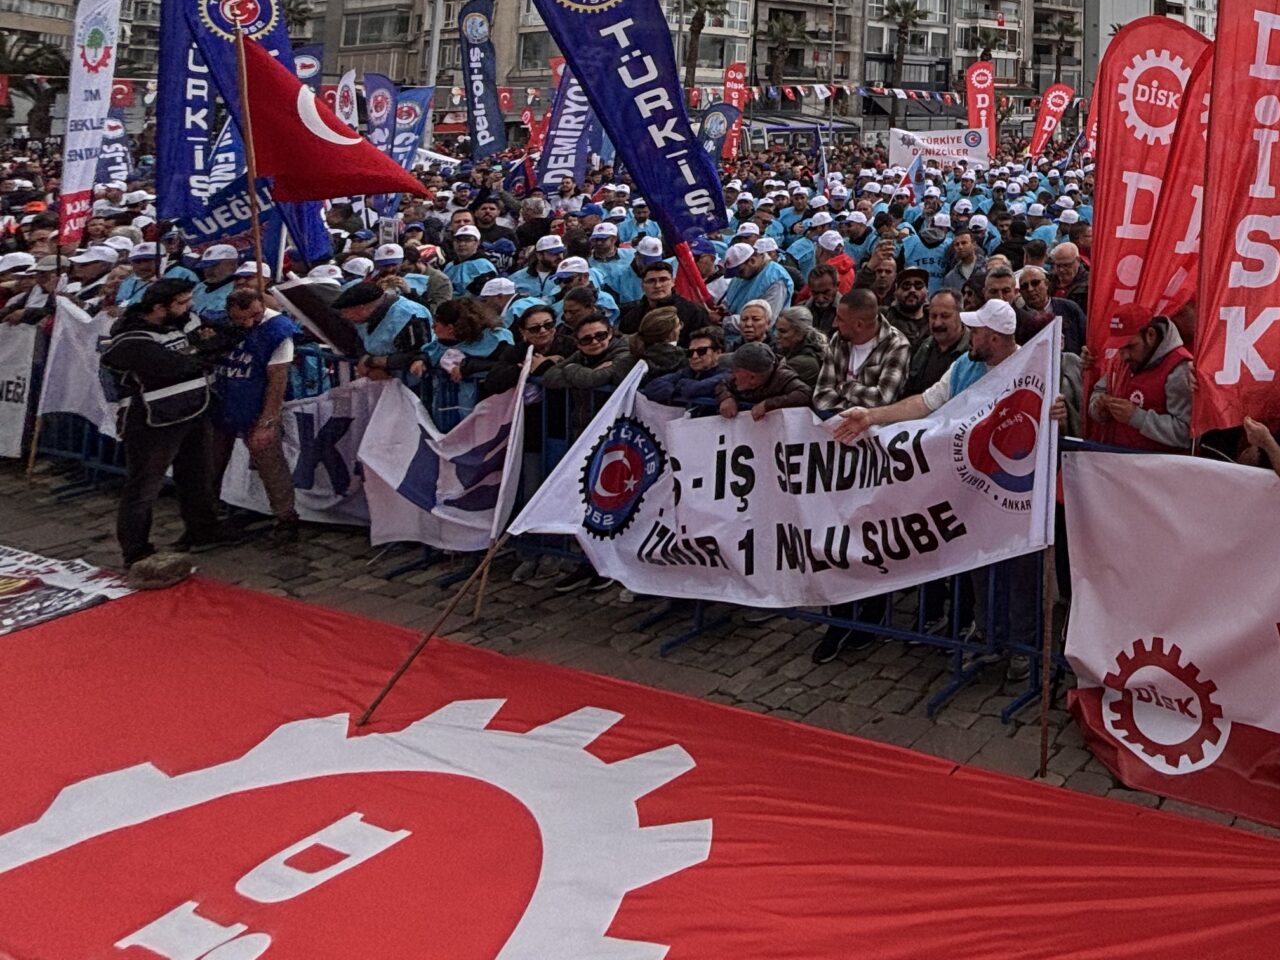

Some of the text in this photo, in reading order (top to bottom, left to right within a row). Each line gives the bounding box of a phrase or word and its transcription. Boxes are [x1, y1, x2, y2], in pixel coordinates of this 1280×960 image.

[1135, 80, 1182, 110] DİSK
[543, 78, 591, 184] DEMİRYO
[1001, 497, 1032, 511] ANKAR
[737, 528, 755, 576] 1
[861, 500, 968, 575] ŞUBE
[1133, 684, 1199, 722] DİSK
